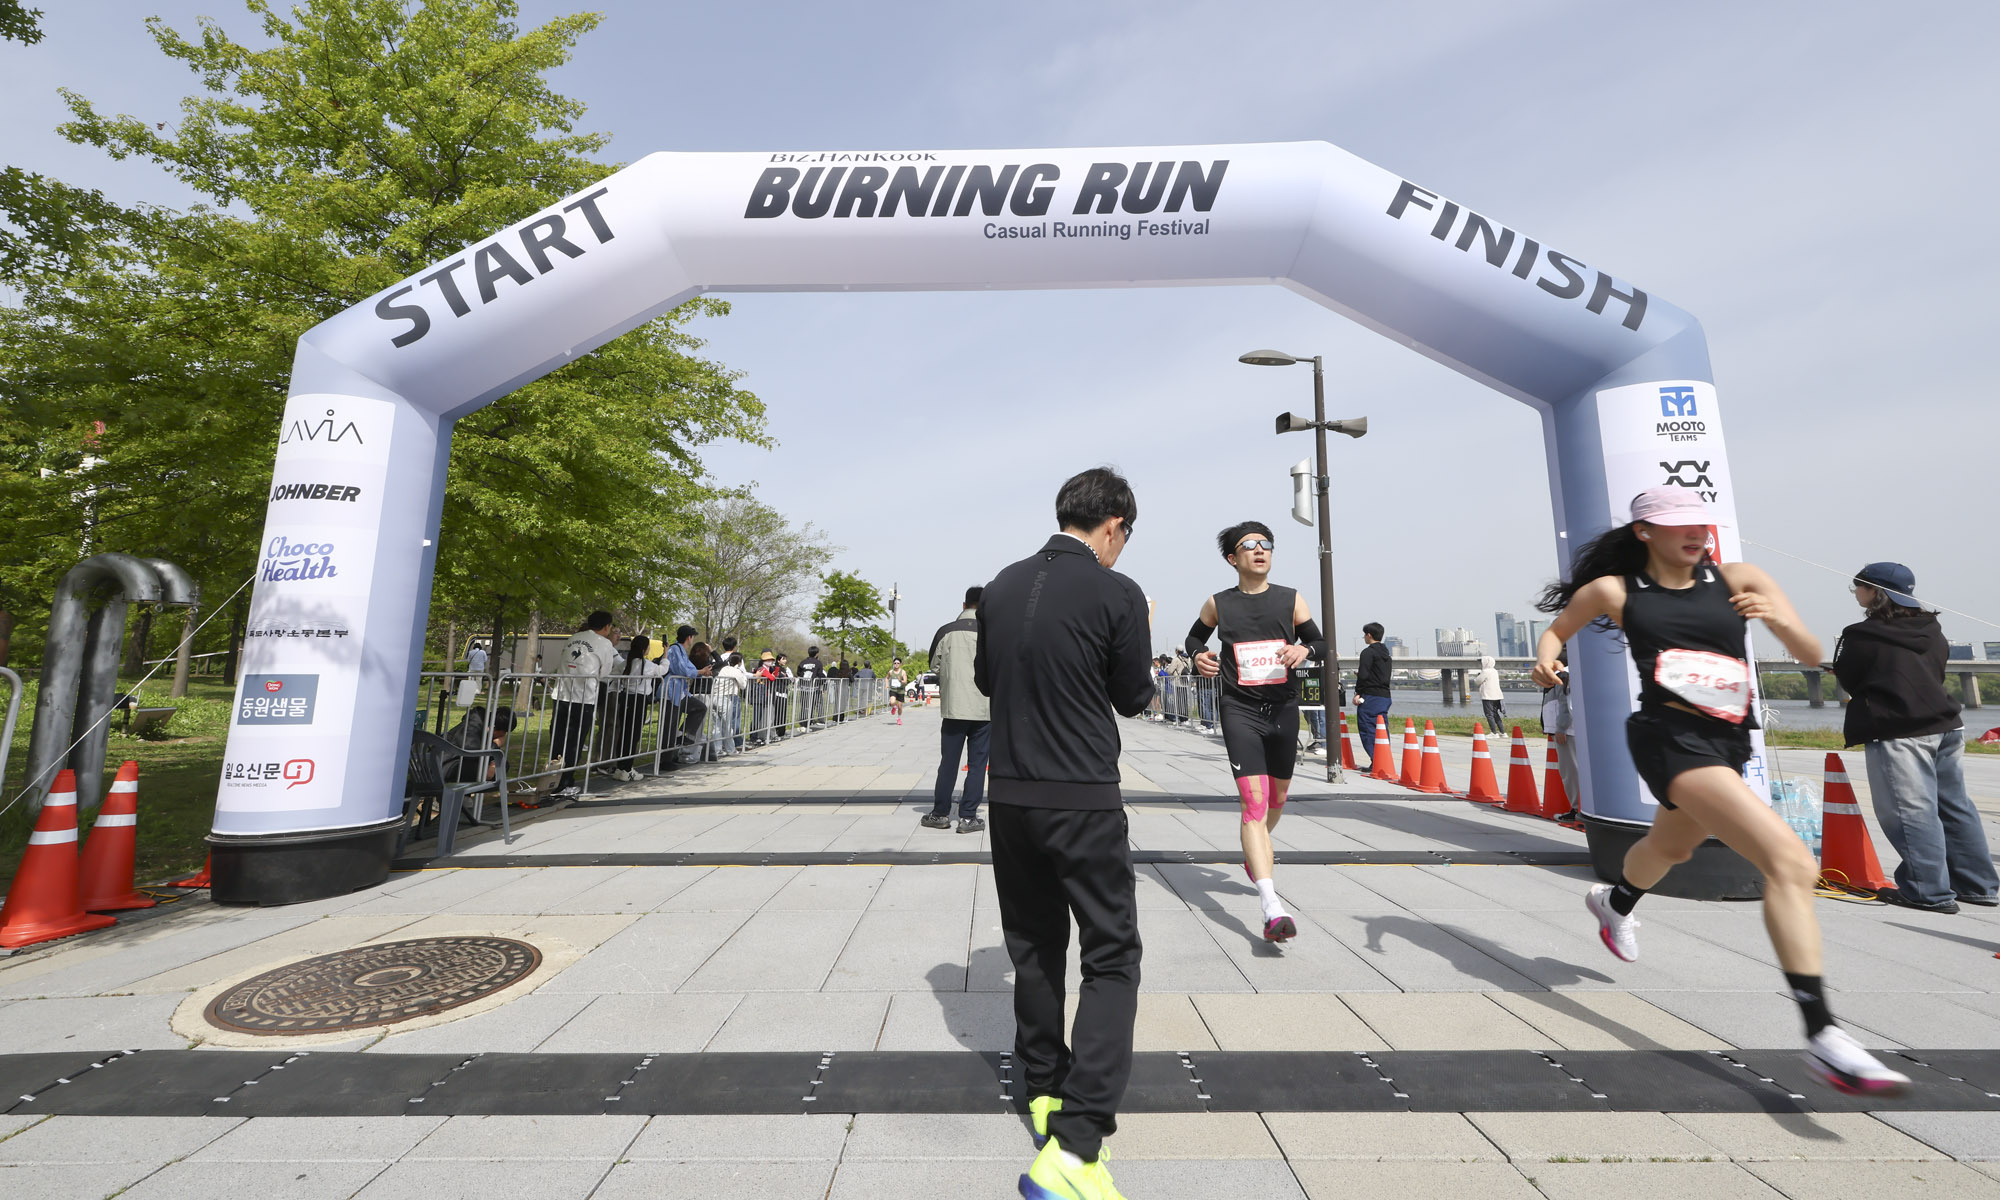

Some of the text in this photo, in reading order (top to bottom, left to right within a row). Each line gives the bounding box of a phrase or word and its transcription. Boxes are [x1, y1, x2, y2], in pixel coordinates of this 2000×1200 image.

[744, 159, 1230, 219] BURNING RUN
[983, 218, 1210, 240] Casual Running Festival
[375, 186, 615, 348] START
[1386, 180, 1648, 332] FINISH
[1656, 421, 1706, 433] MOOTO
[1669, 432, 1698, 442] TEAMS
[270, 483, 361, 502] JOHNBER
[267, 536, 335, 559] Choco
[262, 556, 338, 582] Health
[242, 697, 308, 719] 동원샘물
[225, 762, 281, 780] 일요신문
